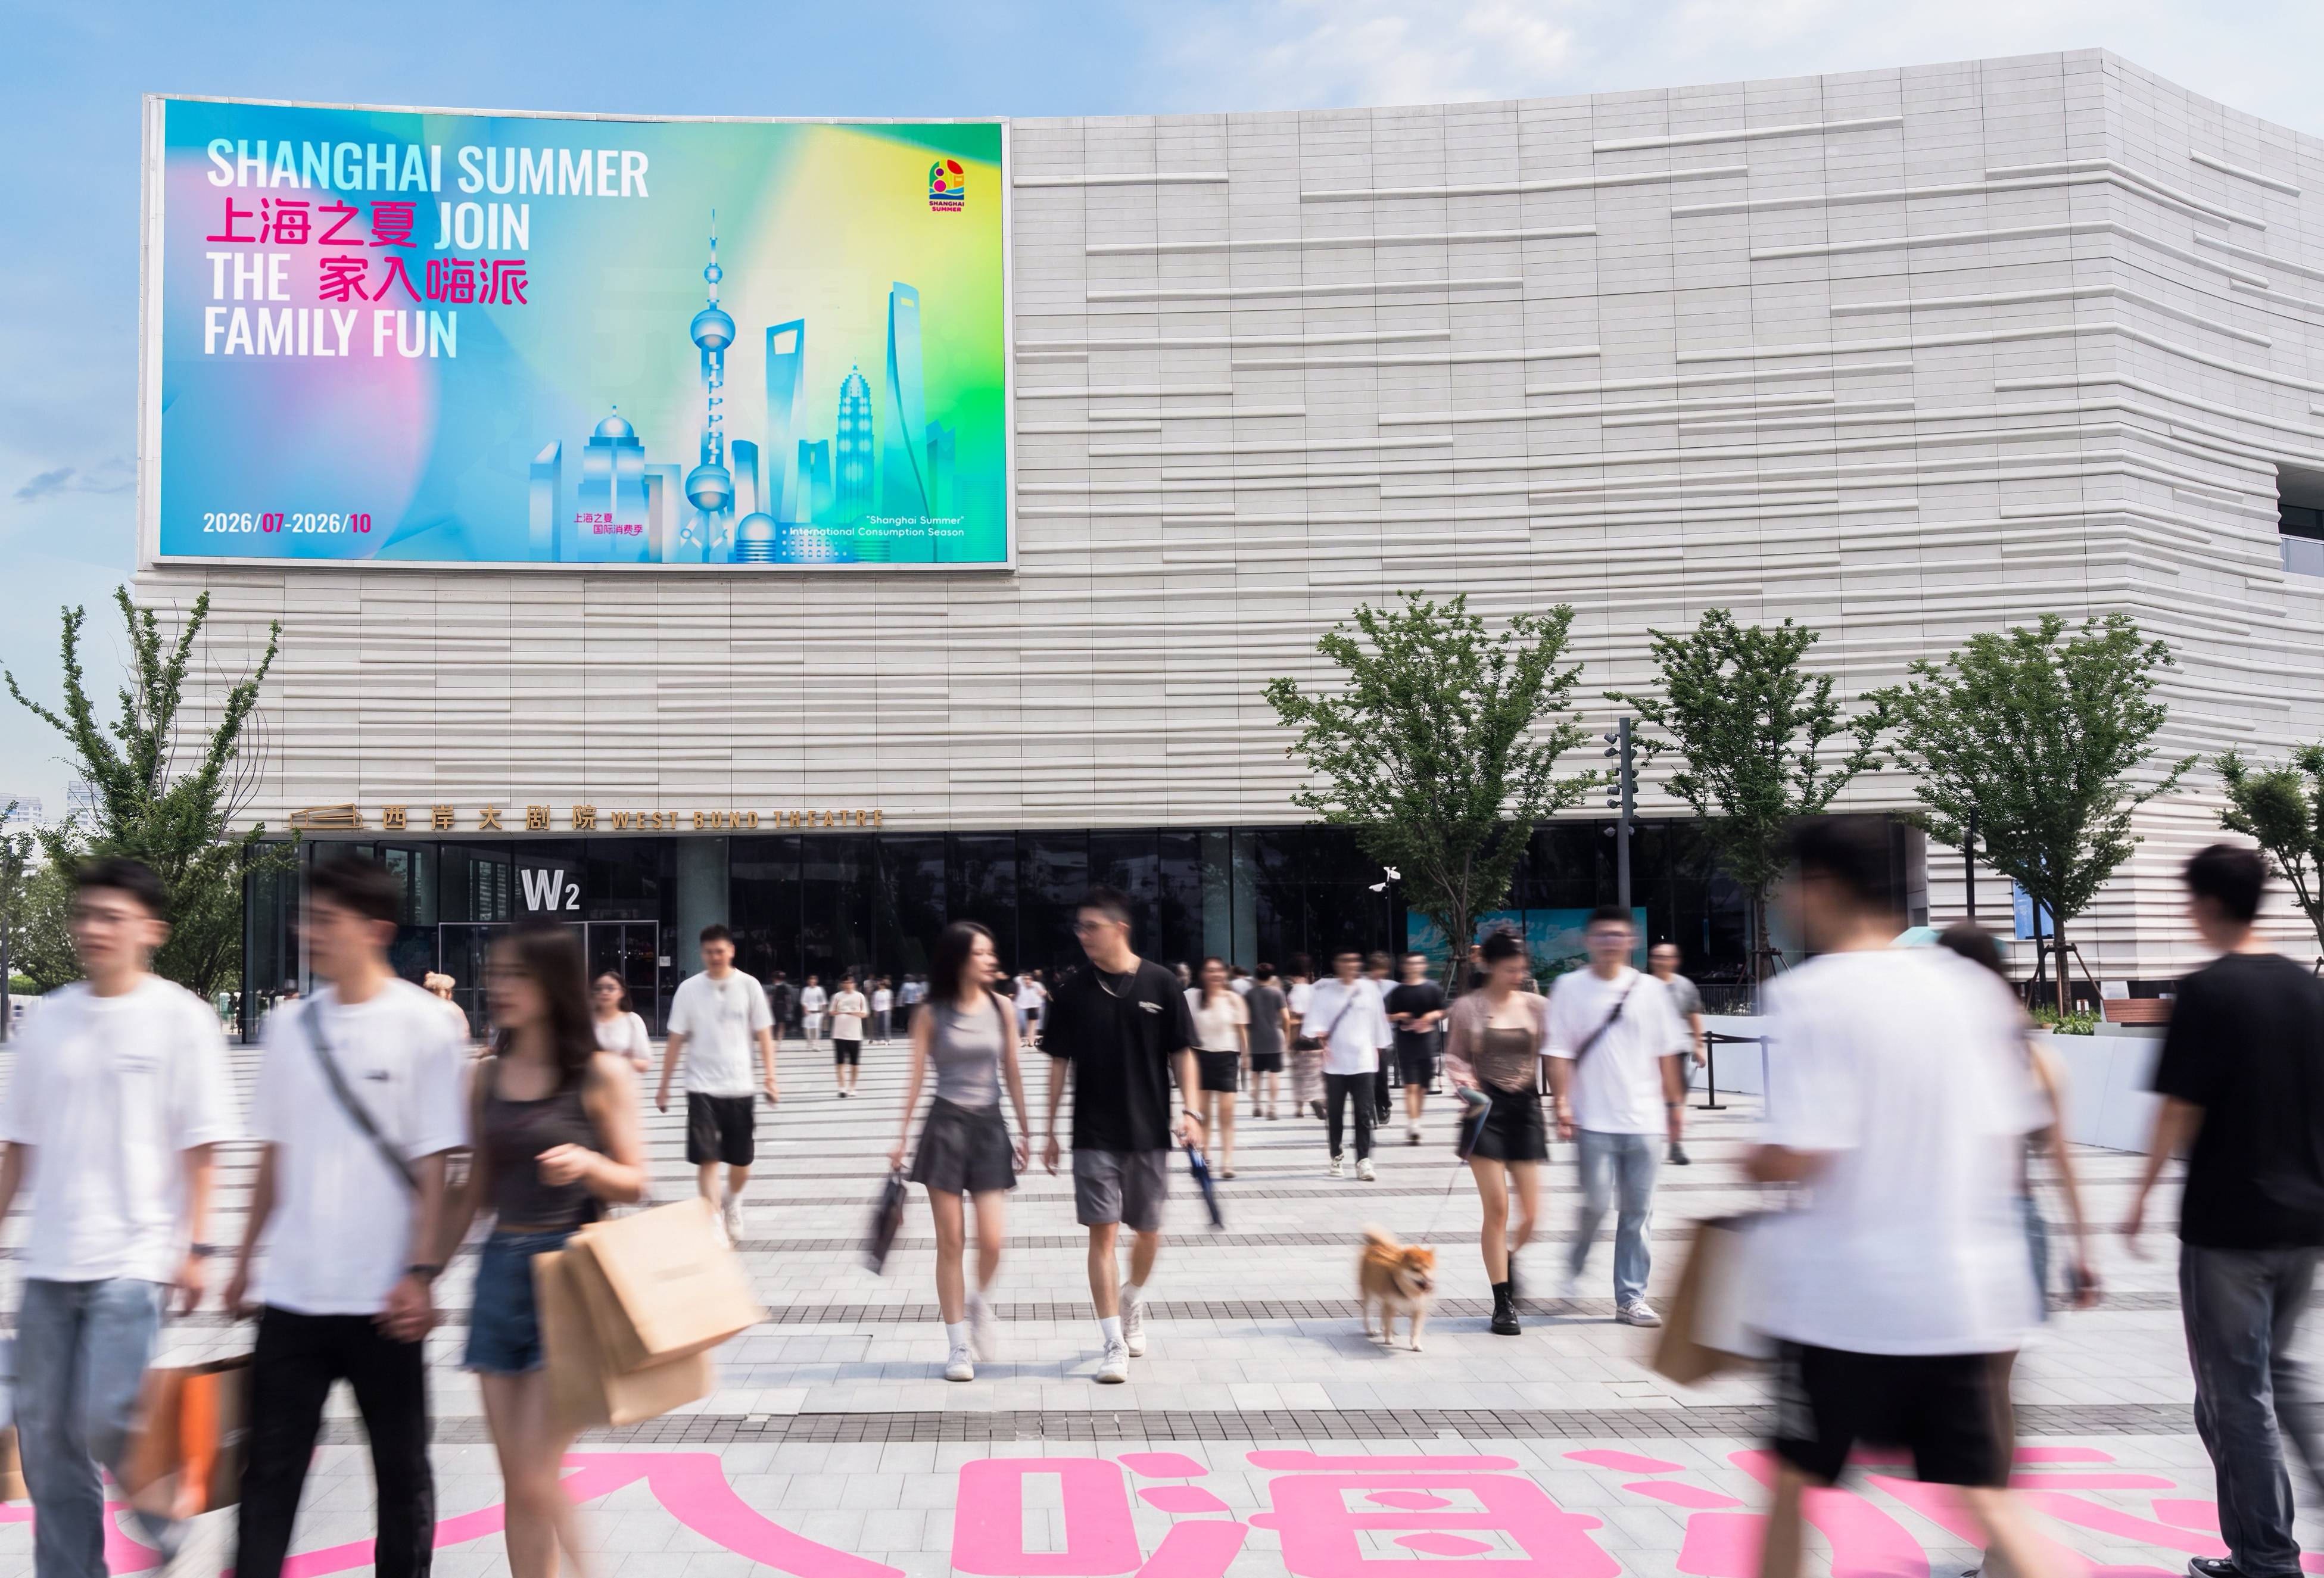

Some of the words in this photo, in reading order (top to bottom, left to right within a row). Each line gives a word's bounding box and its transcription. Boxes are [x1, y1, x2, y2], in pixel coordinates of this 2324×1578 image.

[207, 138, 442, 192] SHANGHAI
[457, 145, 650, 198] SUMMER
[205, 197, 417, 249] 上海之夏
[434, 201, 529, 251] JOIN
[205, 252, 291, 301] THE
[319, 255, 528, 305] 家入嗨派
[204, 306, 359, 357] FAMILY
[373, 309, 457, 358] FUN
[203, 512, 372, 534] 2026/07-2026/10
[574, 513, 613, 523] 上海之夏
[593, 524, 643, 536] 国际消费季
[789, 527, 855, 537] International
[858, 528, 924, 537] Consumption
[927, 528, 964, 537] Season
[382, 804, 597, 830] 西岸大剧院
[611, 812, 679, 829] WEST
[693, 811, 759, 829] BUND
[774, 809, 883, 828] THEATRE
[521, 869, 580, 911] W2
